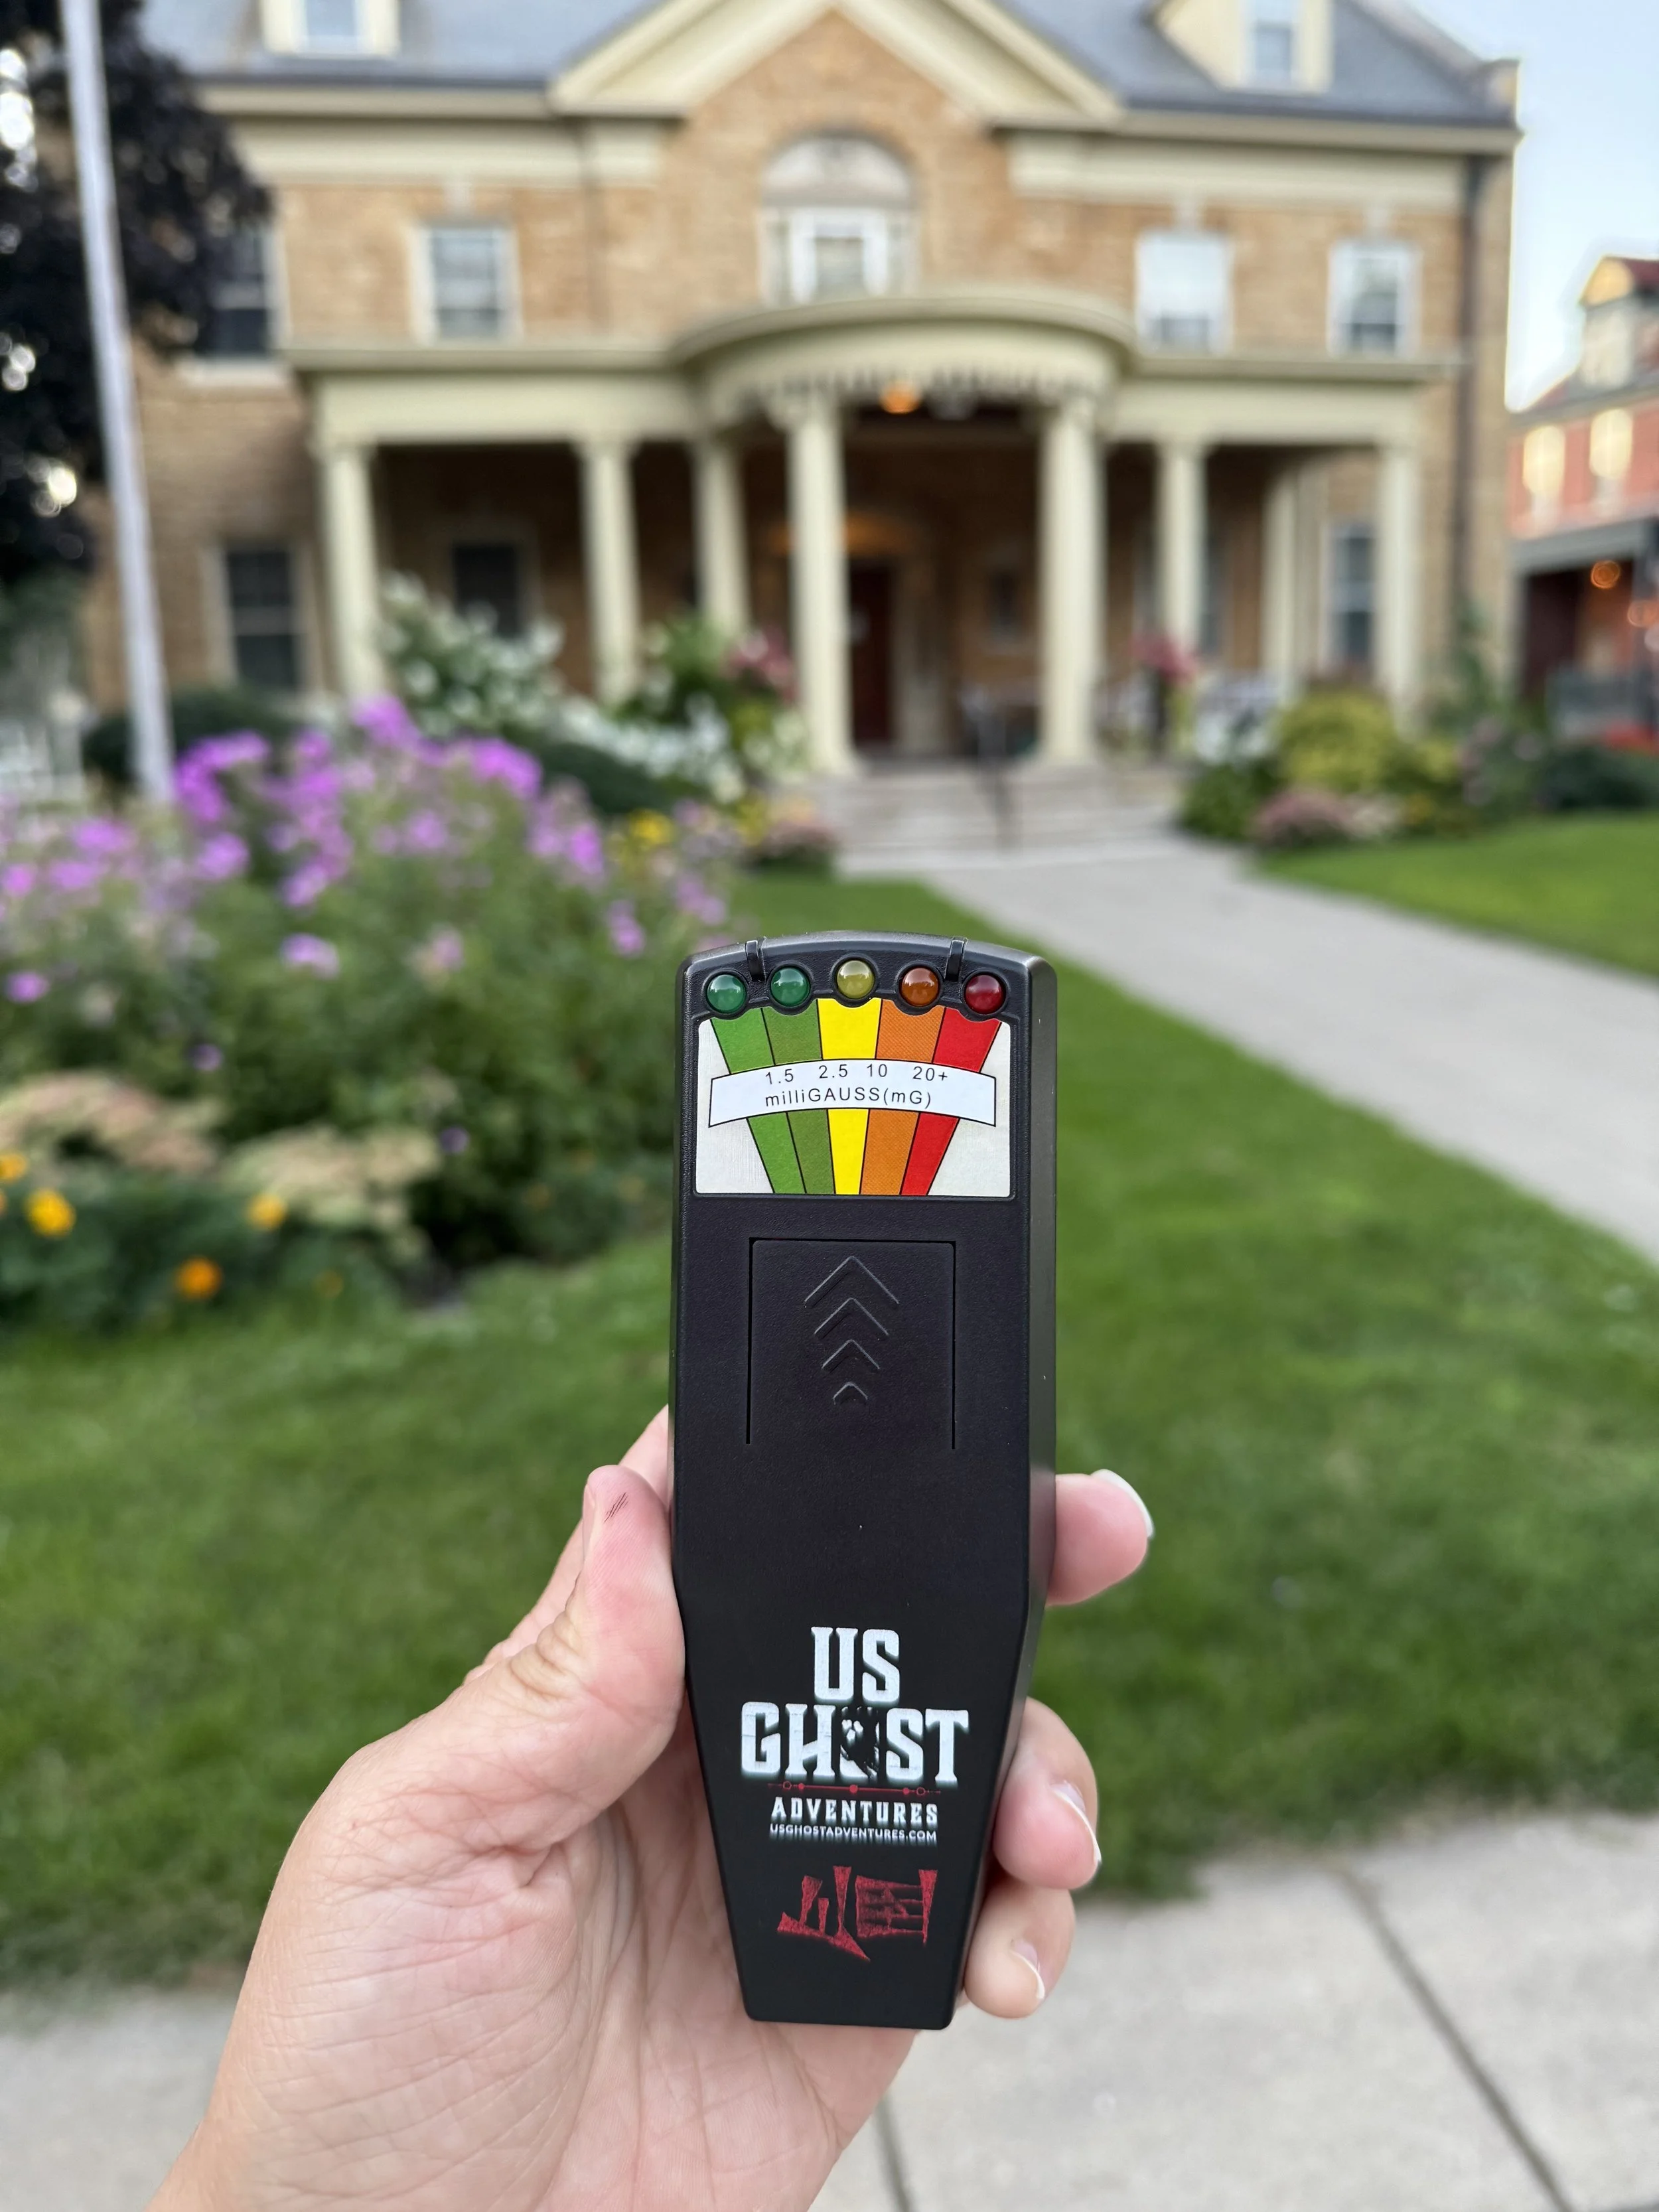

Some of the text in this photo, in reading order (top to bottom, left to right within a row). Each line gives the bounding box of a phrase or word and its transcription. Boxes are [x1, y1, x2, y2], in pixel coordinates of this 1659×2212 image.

[765, 1064, 948, 1084] 1.5 2.5 10 20+
[765, 1087, 932, 1108] milliGAUSS(mG)
[811, 1627, 900, 1703] US
[770, 1797, 938, 1825] ADVENTURES
[770, 1823, 938, 1841] USGHOSTADVENTURES.COM
